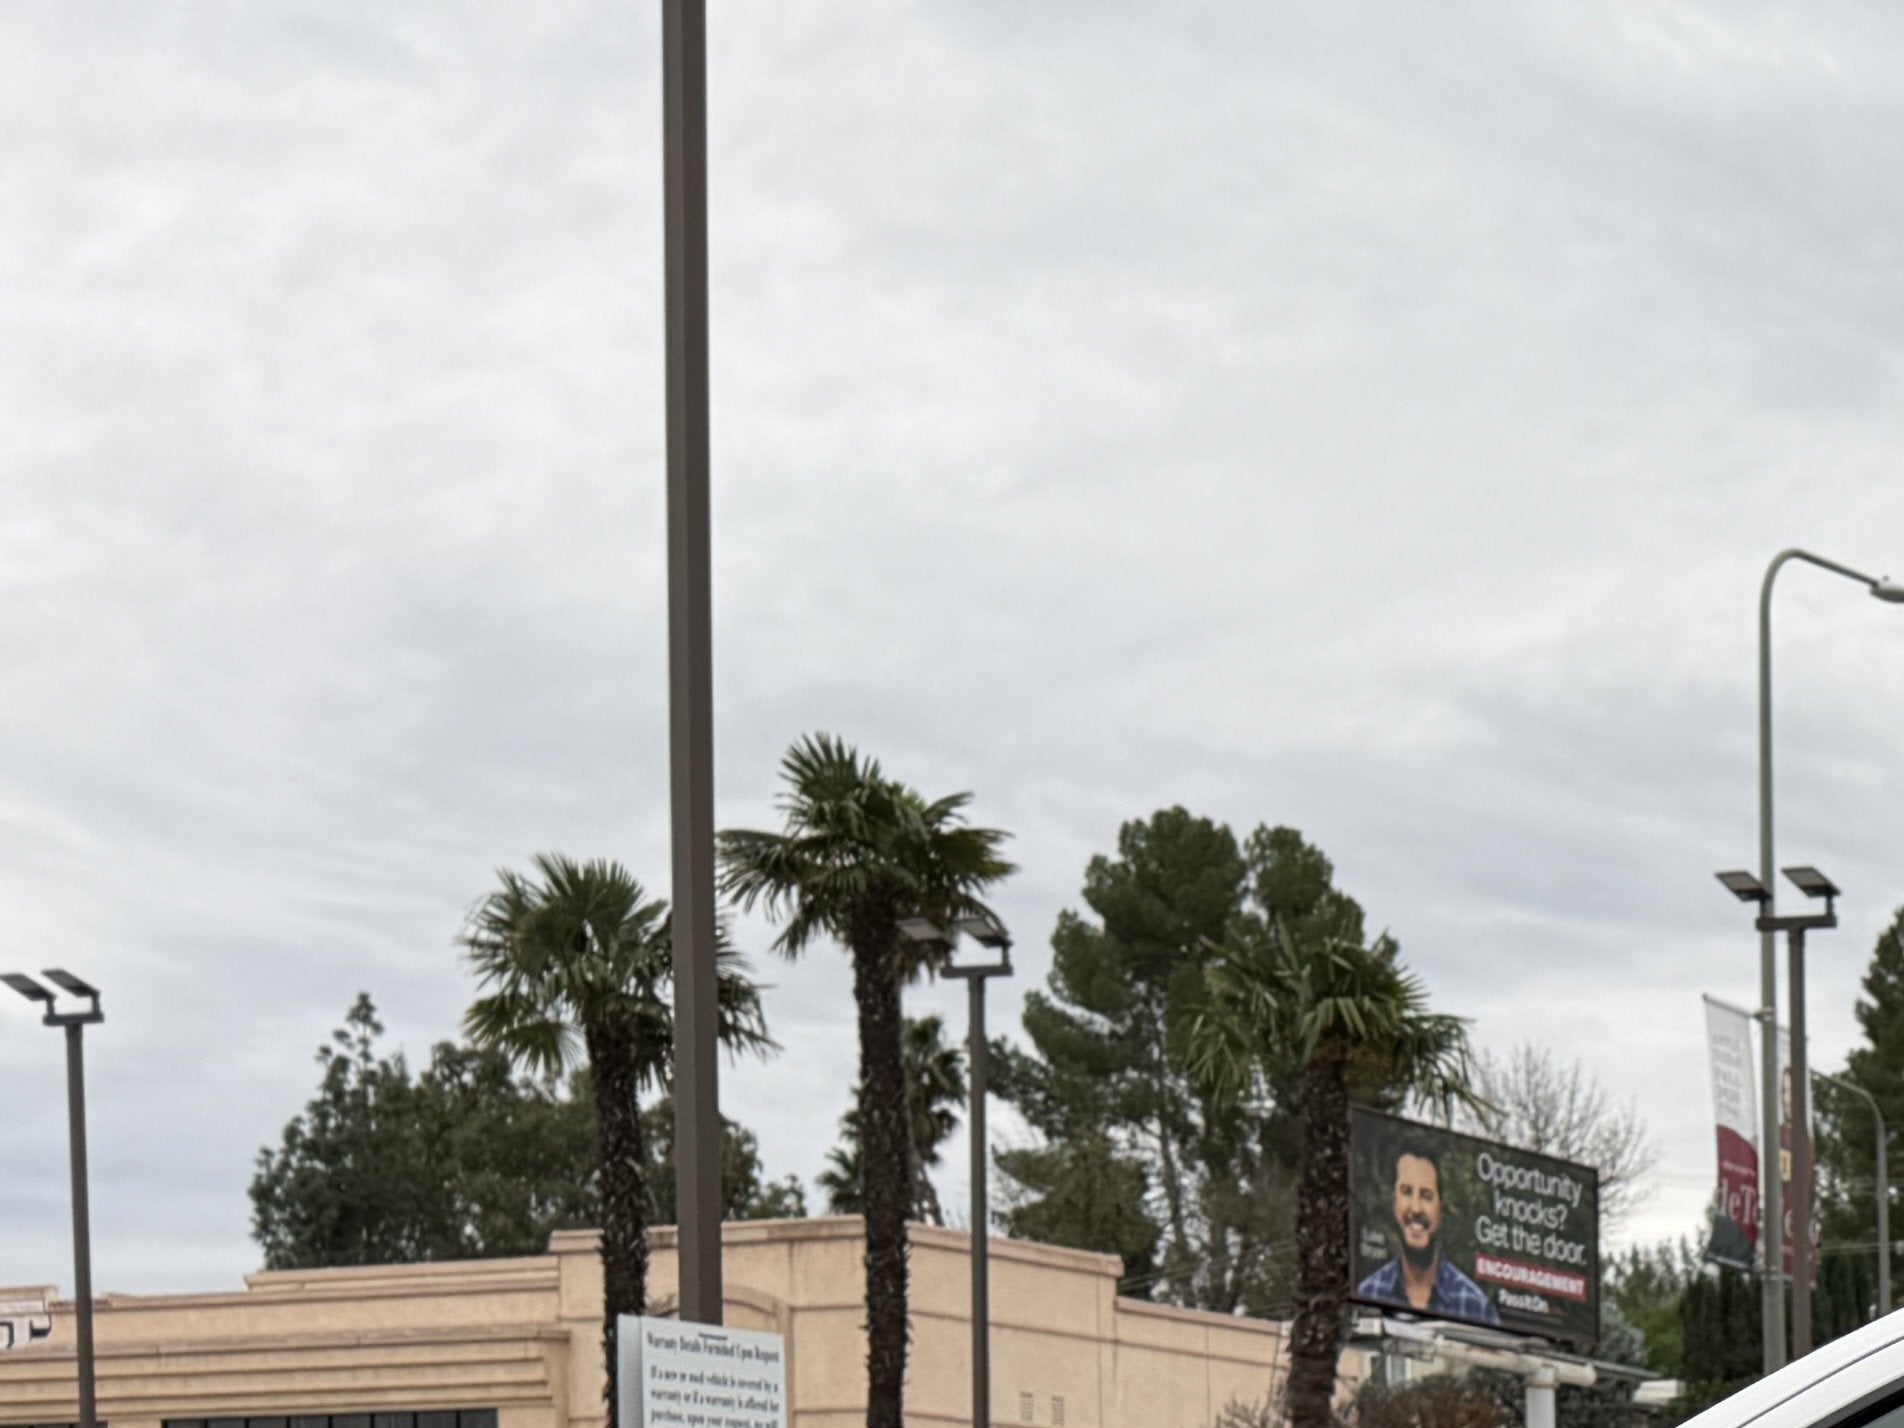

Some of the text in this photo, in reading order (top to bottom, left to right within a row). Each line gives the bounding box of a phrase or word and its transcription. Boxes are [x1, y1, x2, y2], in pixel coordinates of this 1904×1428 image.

[1477, 1152, 1583, 1207] Opportunity
[1494, 1189, 1568, 1230] knocks?
[1475, 1215, 1588, 1265] Get the door.
[1476, 1256, 1585, 1295] ENCOURAGEMENT
